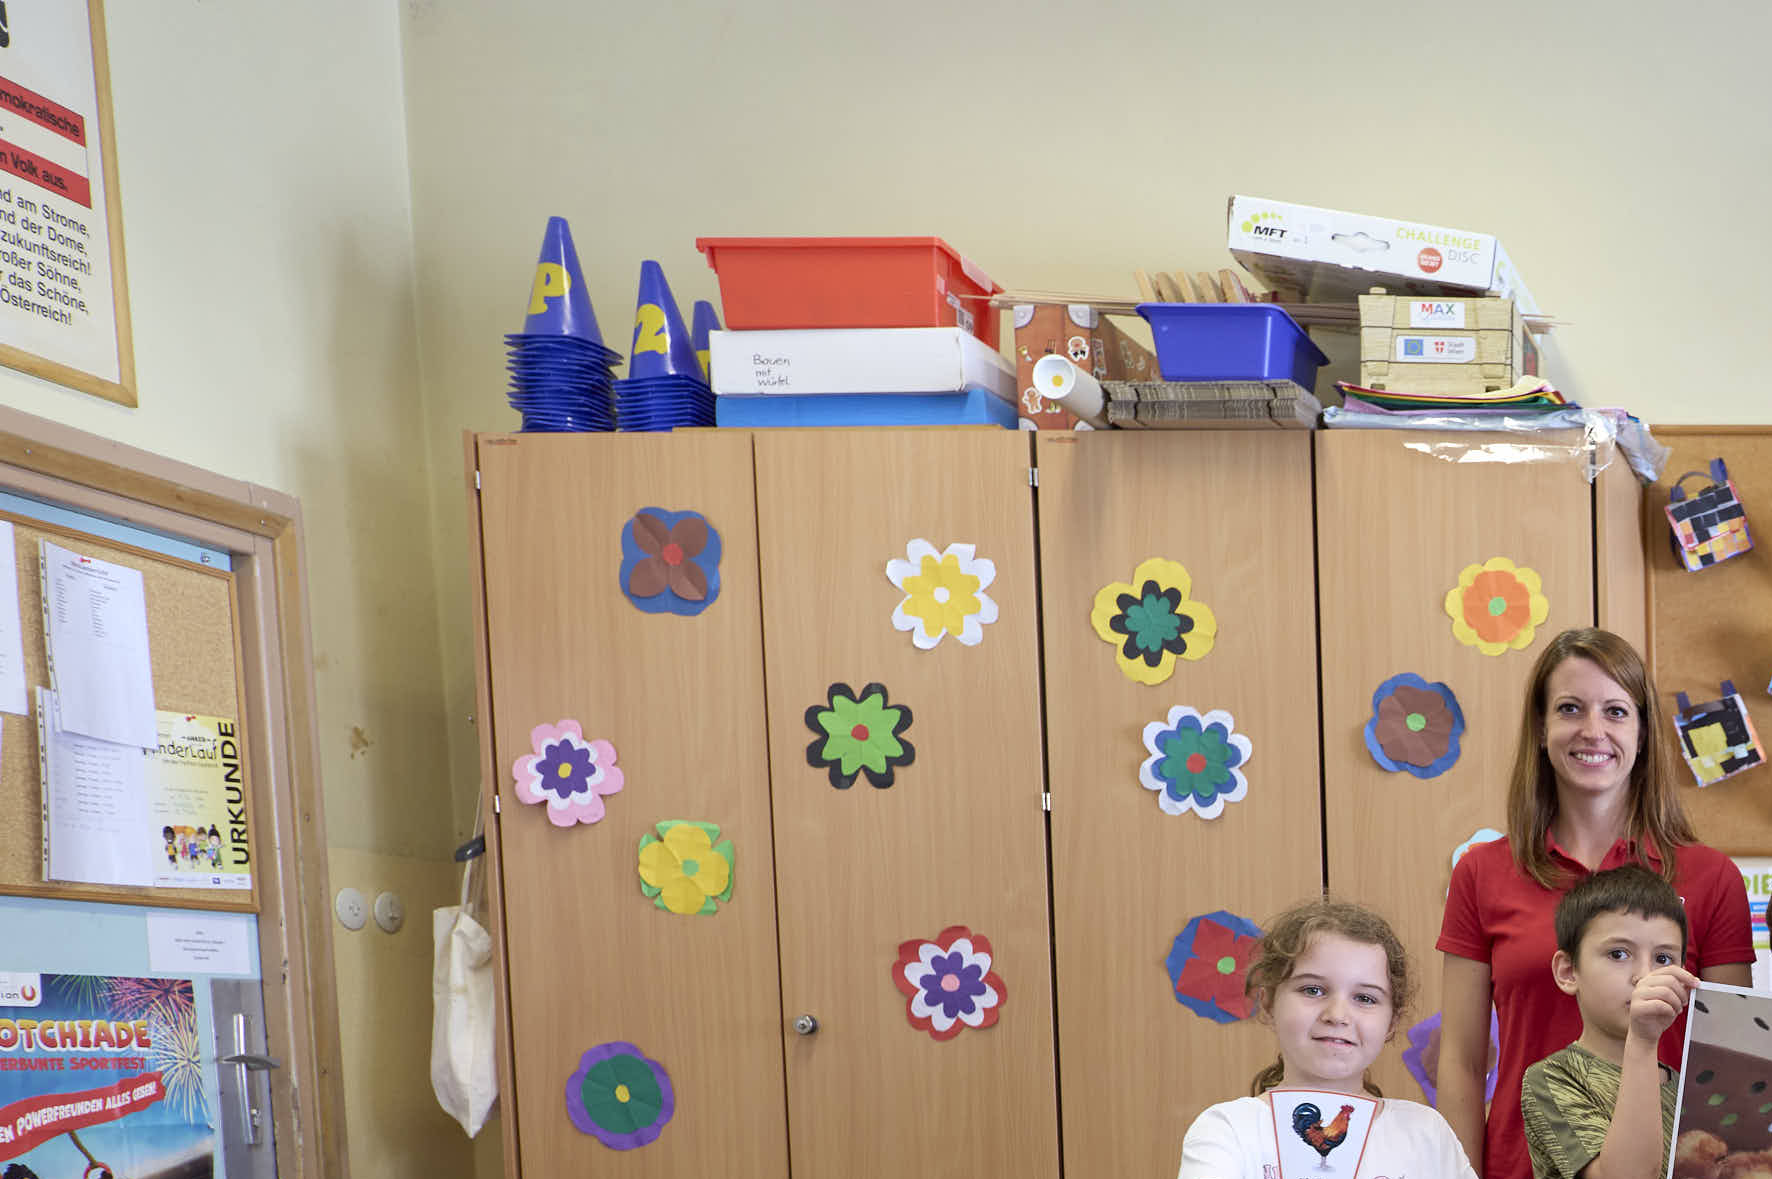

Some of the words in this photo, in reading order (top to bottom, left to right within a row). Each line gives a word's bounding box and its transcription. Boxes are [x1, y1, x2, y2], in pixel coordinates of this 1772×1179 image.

[11, 151, 39, 178] Volk
[41, 168, 69, 192] aus.
[17, 196, 38, 215] am
[41, 203, 90, 239] Strome,
[21, 216, 42, 235] der
[47, 225, 88, 256] Dome,
[1253, 225, 1287, 239] MFT
[1396, 226, 1481, 250] CHALLENGE
[0, 229, 92, 276] zukunftsreich!
[1447, 249, 1481, 265] DISC
[8, 271, 32, 292] das
[37, 280, 88, 316] Schöne,
[37, 261, 81, 293] Söhne,
[527, 262, 572, 315] P
[0, 284, 72, 326] Österreich!
[1421, 303, 1456, 315] MAX
[633, 303, 668, 355] 2
[217, 721, 249, 865] URKUNDE
[69, 1056, 147, 1071] SPORTFEST
[16, 1097, 104, 1137] POWERFREUNDEN
[104, 1090, 132, 1111] ALLES
